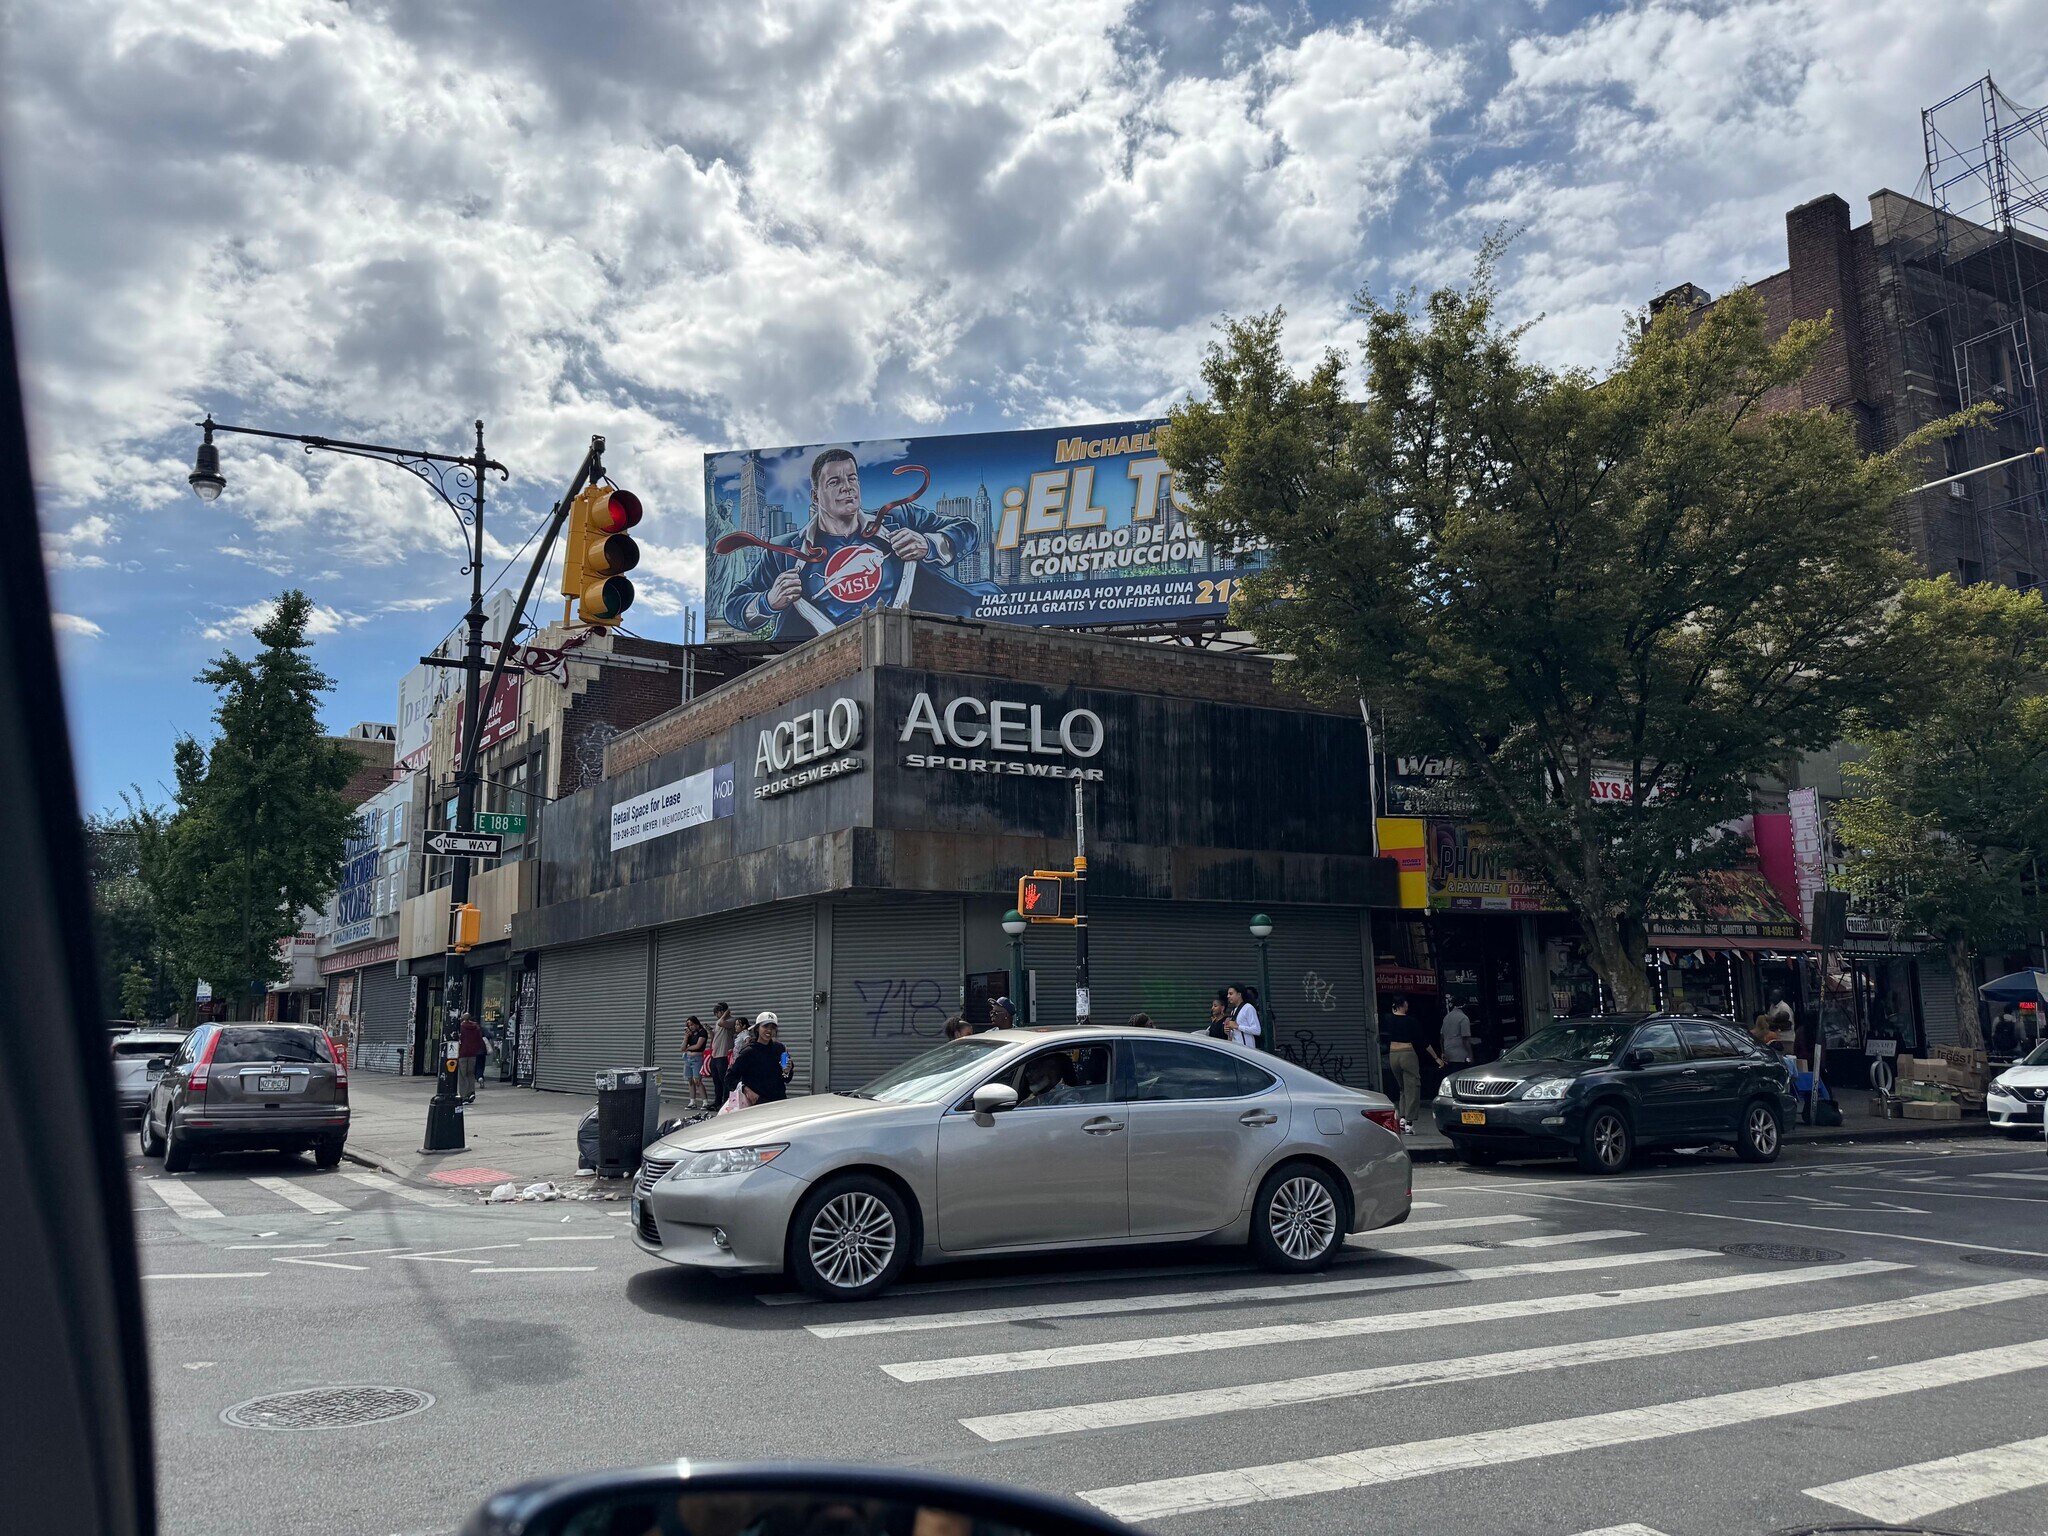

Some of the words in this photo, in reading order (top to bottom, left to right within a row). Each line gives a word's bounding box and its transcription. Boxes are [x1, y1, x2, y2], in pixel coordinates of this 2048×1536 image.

[997, 466, 1106, 549] ¡EL
[1020, 528, 1131, 558] ABOGADO
[1136, 524, 1165, 545] DE
[1030, 541, 1204, 577] CONSTRUCCION
[838, 577, 881, 600] MSL
[981, 593, 1010, 606] HAZ
[1010, 592, 1026, 603] TU
[1029, 588, 1091, 602] LLAMADA
[1095, 586, 1121, 598] HOY
[1125, 584, 1160, 596] PARA
[1164, 582, 1194, 594] UNA
[975, 602, 1038, 617] CONSULTA
[1042, 600, 1085, 613] GRATIS
[1088, 599, 1097, 610] Y
[1099, 594, 1193, 609] CONFIDENCIAL
[899, 692, 1104, 758] ACELO
[754, 697, 858, 778] ACELO
[754, 758, 851, 799] SPORTSWEAR
[906, 754, 1104, 782] SPORTSWEAR
[714, 780, 734, 800] MOD
[613, 807, 631, 826] Retail
[631, 803, 649, 822] Space
[650, 797, 660, 813] for
[661, 792, 681, 809] Lease
[479, 815, 486, 828] E
[491, 816, 509, 831] 188
[513, 817, 522, 826] St
[642, 819, 658, 832] MEYER
[435, 838, 458, 849] ONE
[468, 840, 492, 851] WAY
[1448, 882, 1455, 892] &
[1456, 882, 1502, 894] PAYMENT
[337, 882, 373, 927] STORE
[333, 928, 352, 945] AMAZING
[352, 922, 370, 939] PRICES
[485, 1010, 496, 1021] SALE
[1941, 1052, 1966, 1064] EGGS
